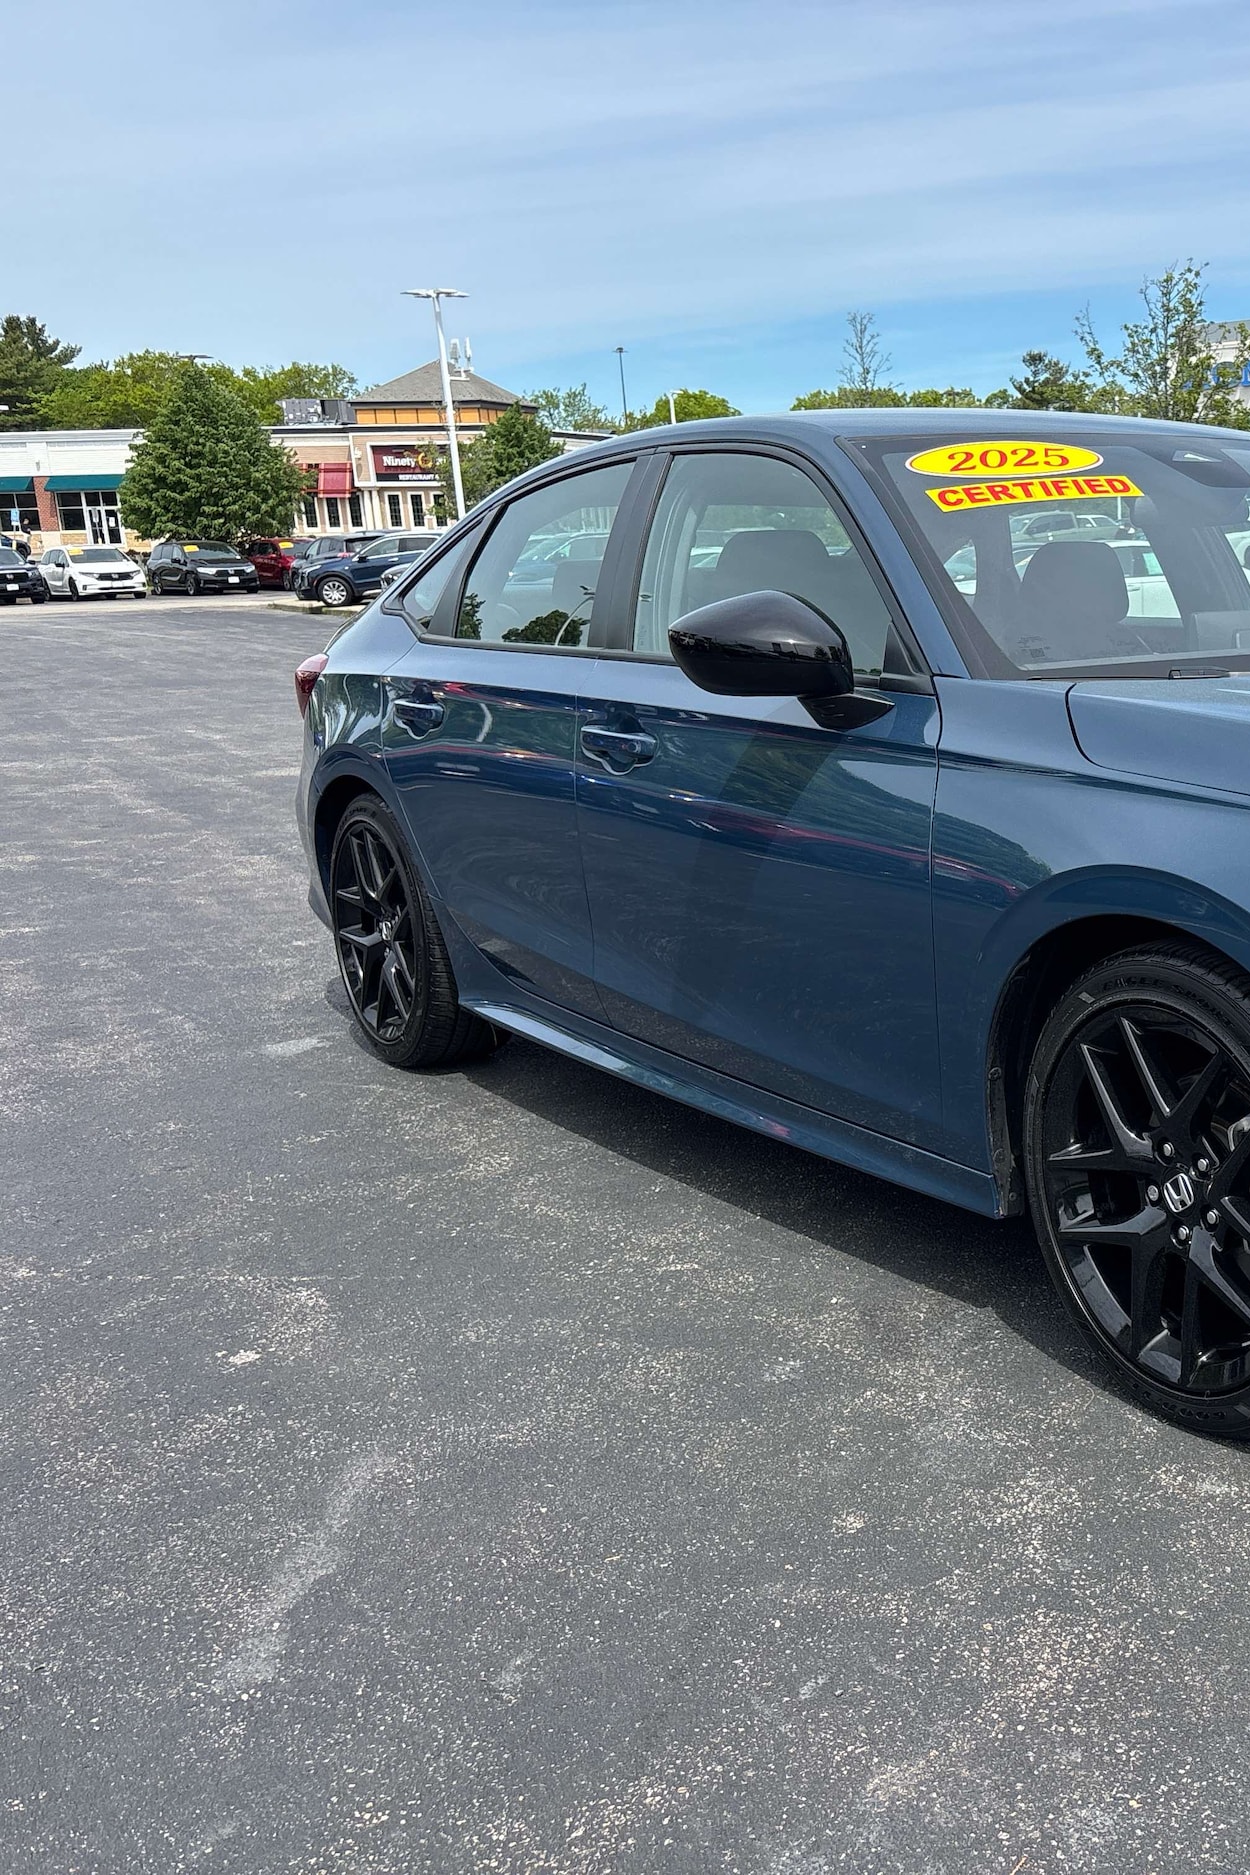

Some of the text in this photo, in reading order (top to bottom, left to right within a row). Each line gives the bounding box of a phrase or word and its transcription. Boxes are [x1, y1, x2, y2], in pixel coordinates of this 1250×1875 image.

[382, 455, 416, 467] Ninety
[947, 447, 1070, 473] 2025
[937, 478, 1132, 507] CERTIFIED
